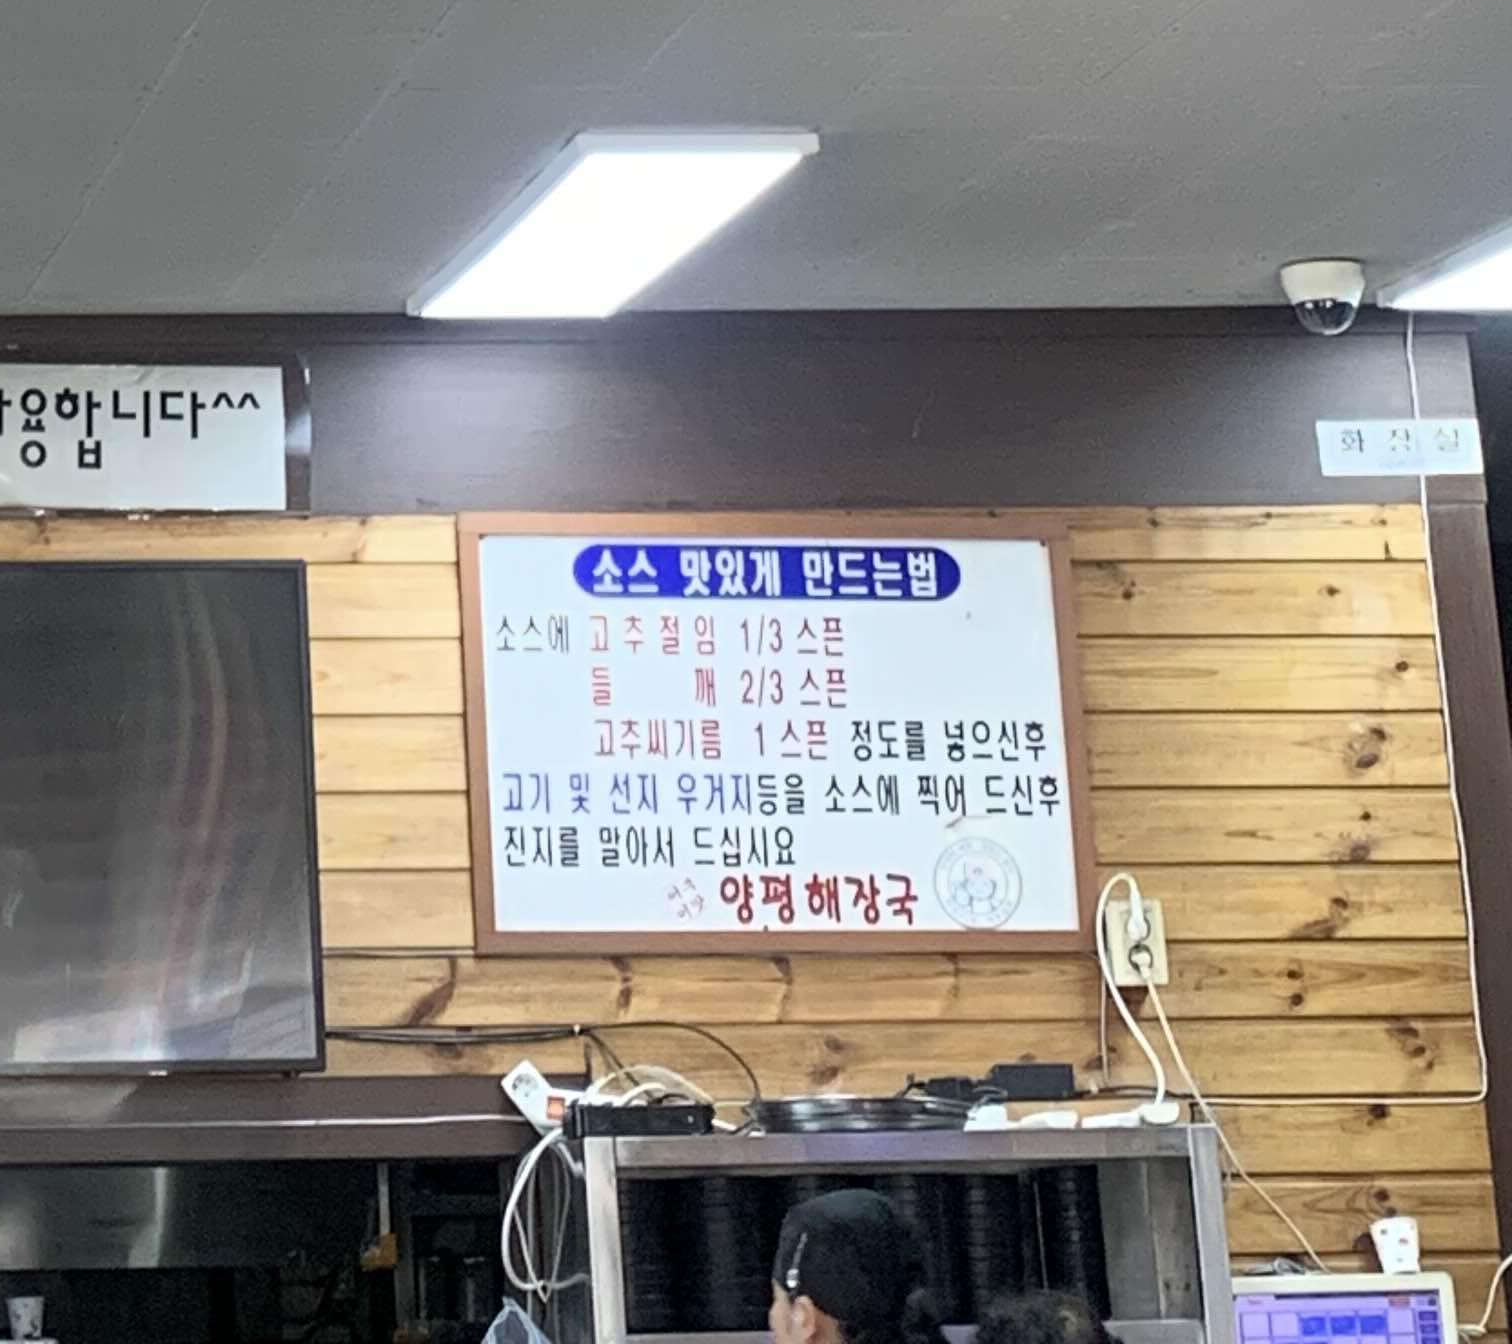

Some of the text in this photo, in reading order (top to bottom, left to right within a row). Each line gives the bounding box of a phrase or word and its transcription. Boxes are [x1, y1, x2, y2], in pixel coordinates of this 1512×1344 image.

[592, 549, 938, 598] 소스 맛있게 만드는법
[496, 615, 570, 653] 소스에
[740, 615, 784, 655] 1/3
[740, 667, 784, 707] 2/3
[594, 719, 722, 760] 고추씨기름
[755, 722, 765, 757] 1
[851, 720, 926, 762] 정도를
[944, 720, 1046, 763] 넣으신후
[503, 772, 1060, 817] 고기 및 선지 우거지등을 소스에 찍어 드신후
[504, 825, 796, 868] 진지를 말아서 드십시요
